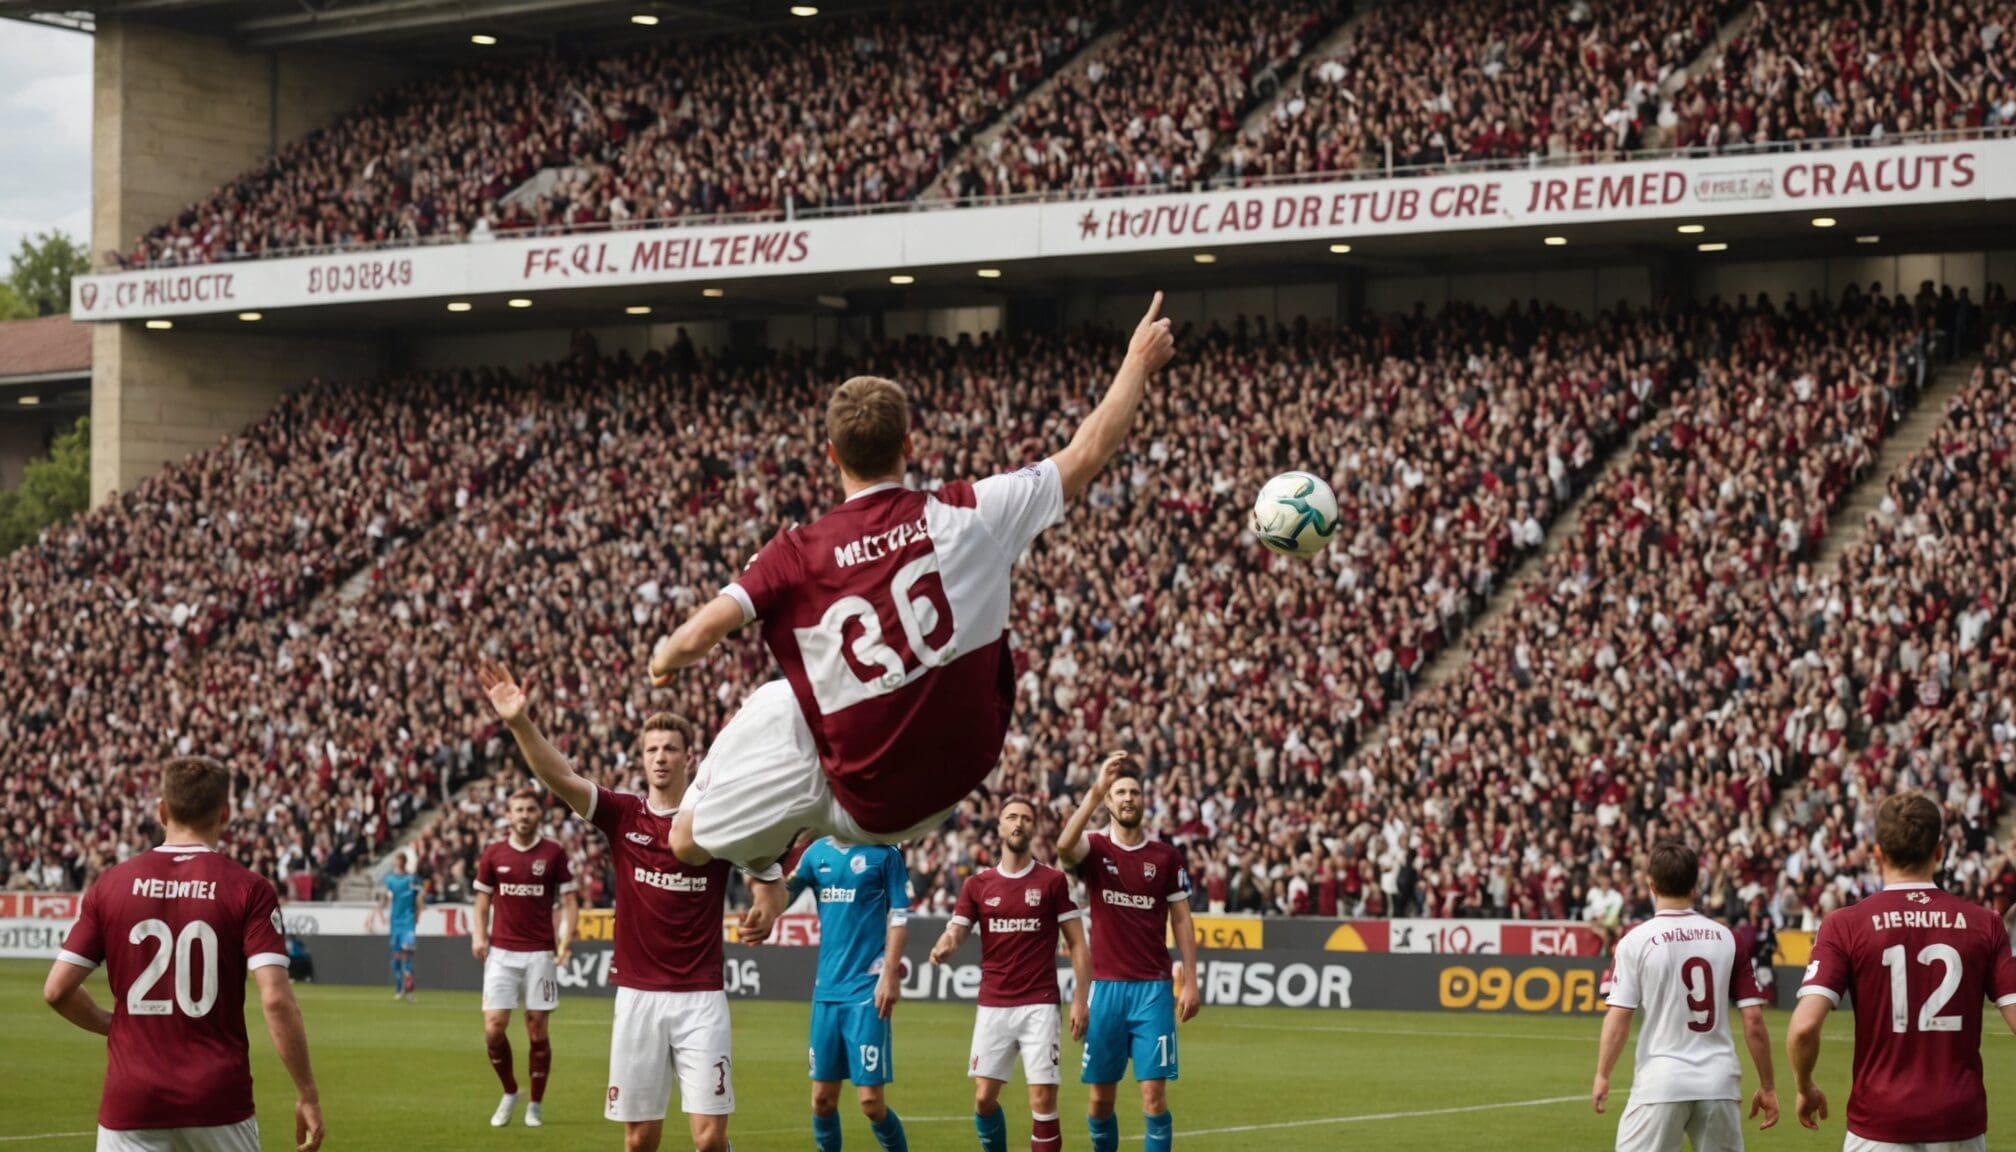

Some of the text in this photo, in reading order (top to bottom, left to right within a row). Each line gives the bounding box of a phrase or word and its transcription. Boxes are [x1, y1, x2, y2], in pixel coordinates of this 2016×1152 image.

[1783, 153, 1976, 199] CRACUTS
[127, 918, 218, 1018] 20
[1681, 956, 1716, 1033] 9
[1881, 943, 1963, 1032] 12
[859, 1044, 879, 1072] 19
